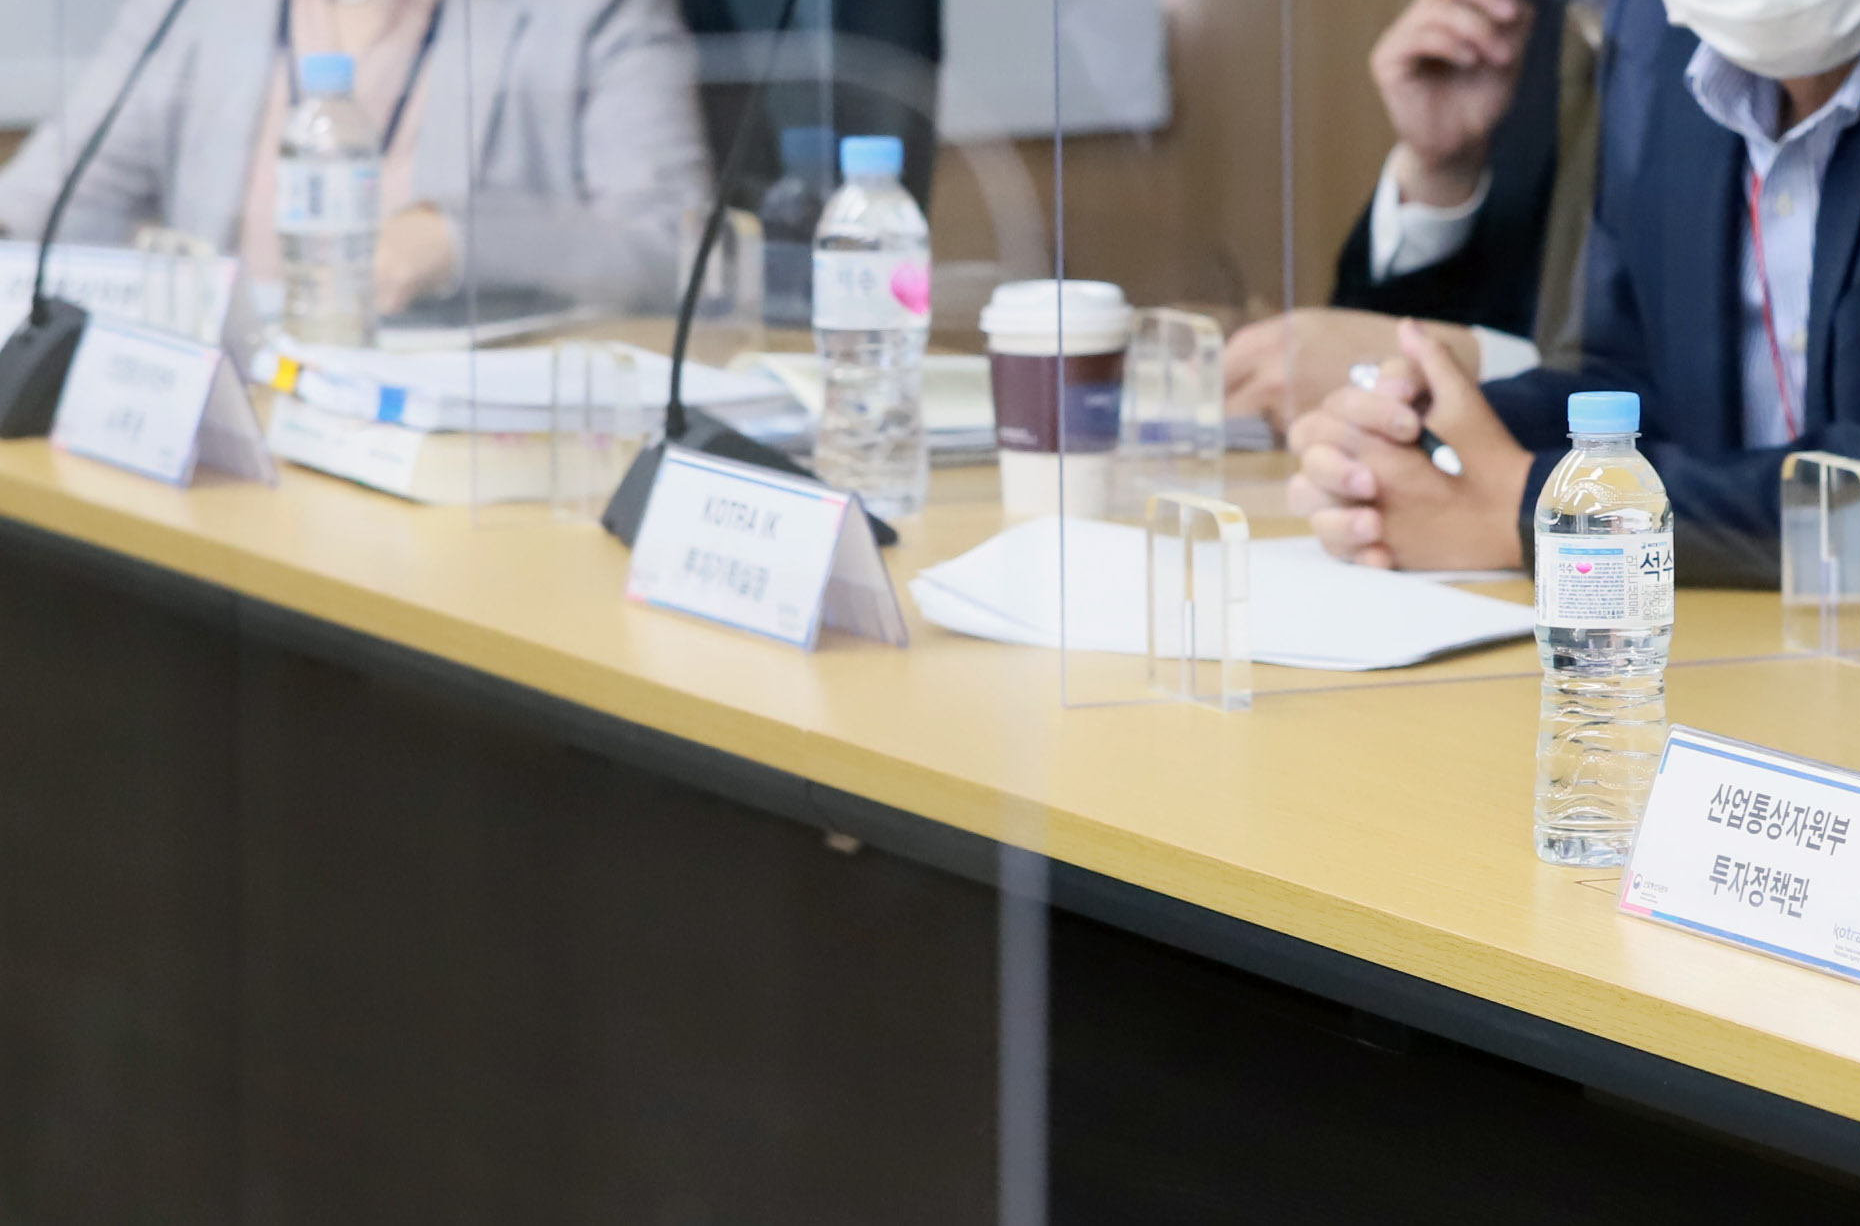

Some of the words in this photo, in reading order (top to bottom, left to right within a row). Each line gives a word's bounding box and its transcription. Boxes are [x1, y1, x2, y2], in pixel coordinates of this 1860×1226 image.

[1640, 549, 1673, 582] 석수
[1707, 783, 1851, 856] 산업통상자원부
[1709, 854, 1810, 919] 투자정책관
